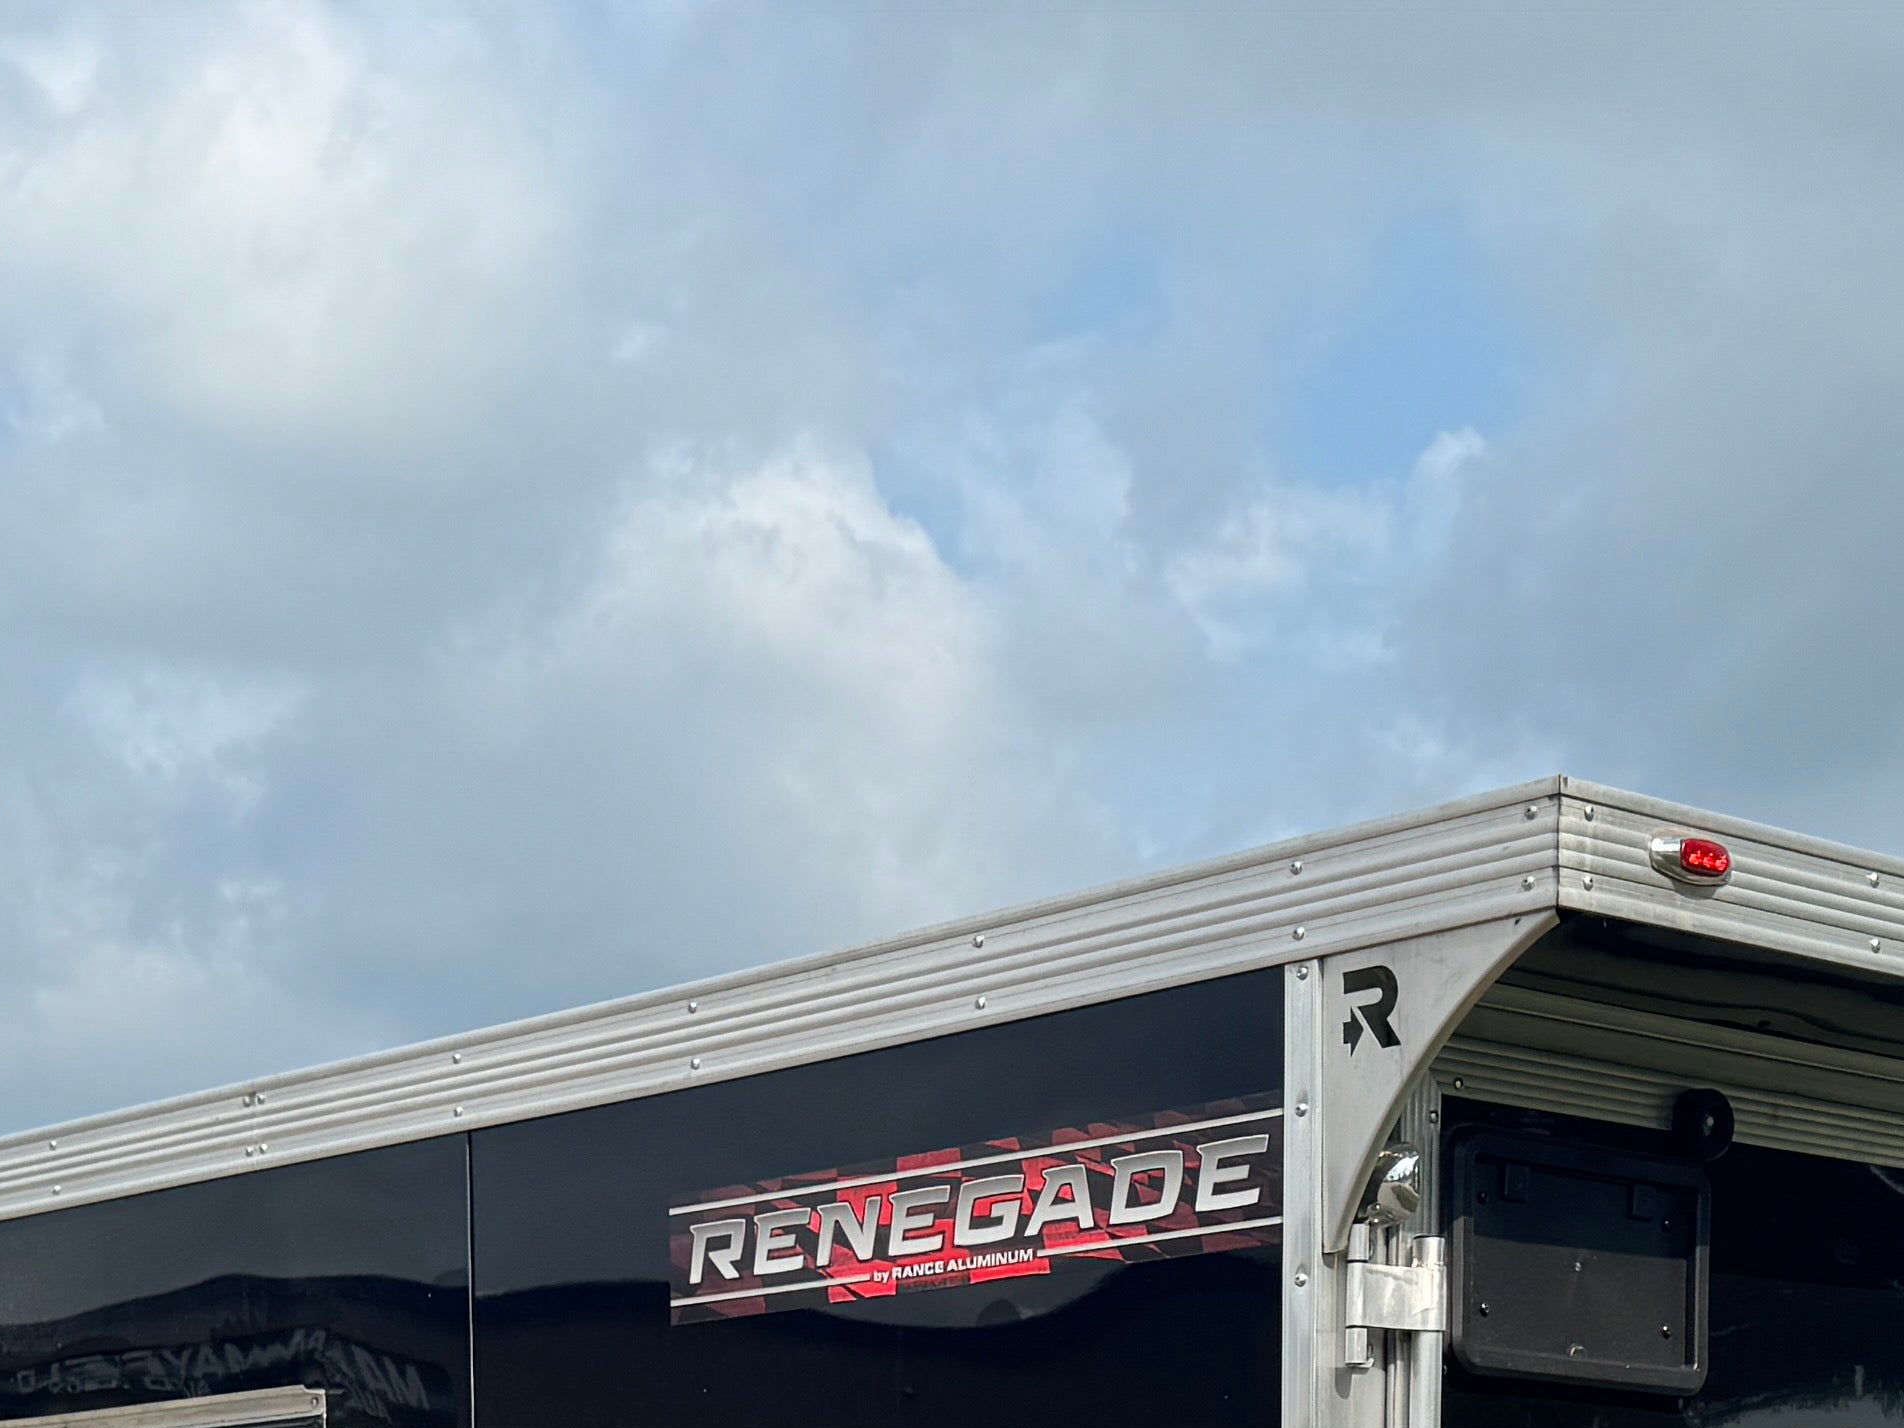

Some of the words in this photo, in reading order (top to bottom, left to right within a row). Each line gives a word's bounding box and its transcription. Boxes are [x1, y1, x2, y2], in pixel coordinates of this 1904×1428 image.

[688, 1133, 1270, 1285] RENEGADE
[873, 1270, 890, 1284] by
[891, 1260, 945, 1280] RANCE
[946, 1248, 1034, 1273] ALUMINUM
